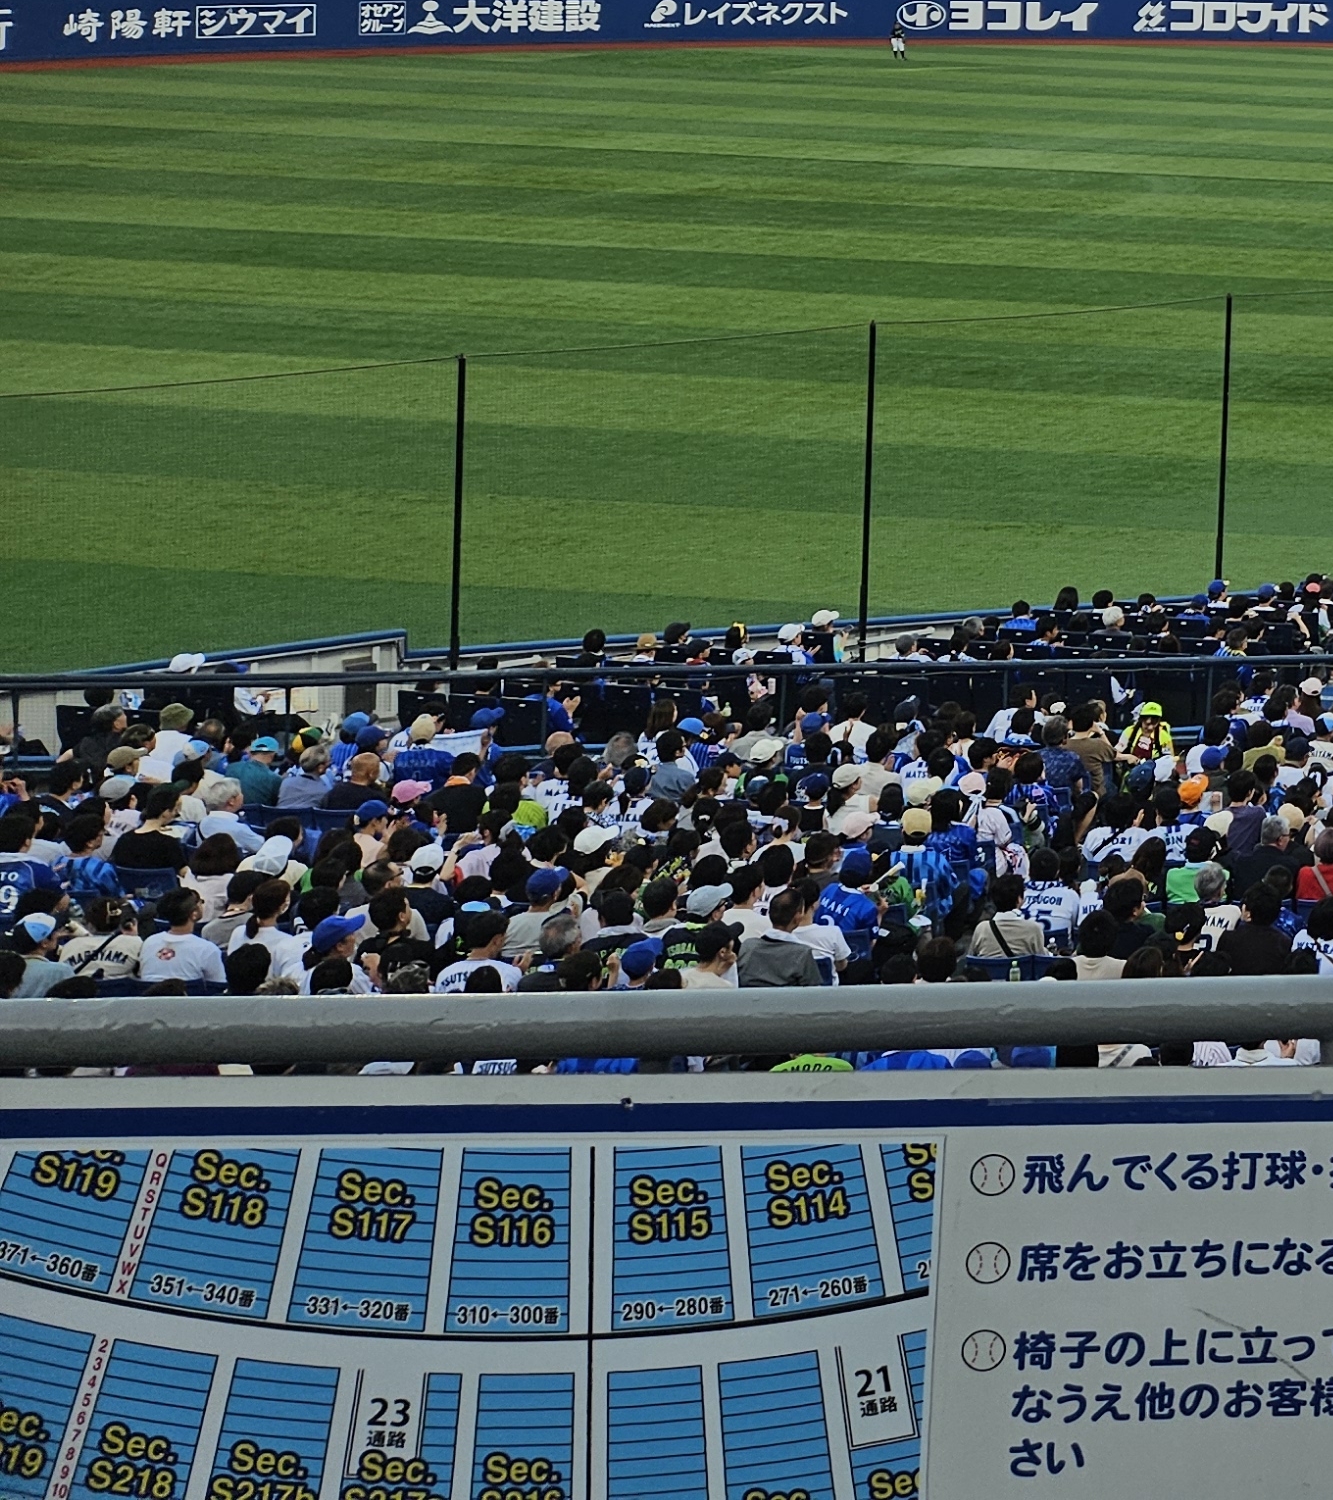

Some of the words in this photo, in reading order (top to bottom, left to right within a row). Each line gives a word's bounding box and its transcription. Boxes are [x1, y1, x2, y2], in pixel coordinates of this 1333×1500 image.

[63, 8, 191, 41] 崎陽軒
[200, 8, 312, 35] シウマイ
[361, 4, 404, 17] オセアン
[454, 0, 601, 33] 大洋建設
[683, 1, 847, 26] レイズネクスト
[947, 0, 1099, 31] ヨコレイ
[1171, 0, 1330, 35] コロワイド
[361, 19, 404, 33] グループ
[820, 899, 851, 918] MAKI
[35, 1155, 117, 1198] S119
[194, 1154, 269, 1189] Sec.
[767, 1163, 839, 1191] Sec.
[339, 1171, 412, 1202] Sec.
[478, 1180, 551, 1209] Sec.
[632, 1178, 704, 1204] Sec.
[183, 1189, 265, 1226] S118
[770, 1191, 847, 1227] S114
[332, 1208, 412, 1238] S117
[472, 1216, 551, 1245] S116
[632, 1211, 708, 1240] S115
[46, 1253, 98, 1282] 360番
[150, 1274, 184, 1297] 351
[204, 1283, 255, 1308] 340番
[768, 1287, 800, 1307] 271
[820, 1276, 868, 1298] 260番
[306, 1297, 339, 1314] 331
[360, 1300, 410, 1321] 320番
[457, 1306, 489, 1324] 310
[509, 1306, 559, 1324] 300番
[622, 1302, 656, 1321] 290
[676, 1297, 724, 1316] 280番
[855, 1366, 891, 1397] 21
[366, 1398, 410, 1426] 23
[861, 1397, 897, 1416] 通路
[103, 1425, 177, 1462] Sec.
[366, 1431, 406, 1447] 通路
[233, 1444, 306, 1477] Sec.
[360, 1452, 436, 1482] Sec.
[486, 1455, 560, 1482] Sec.
[1009, 1441, 1085, 1477] さい
[52, 1483, 67, 1498] 10
[87, 1462, 175, 1498] S218
